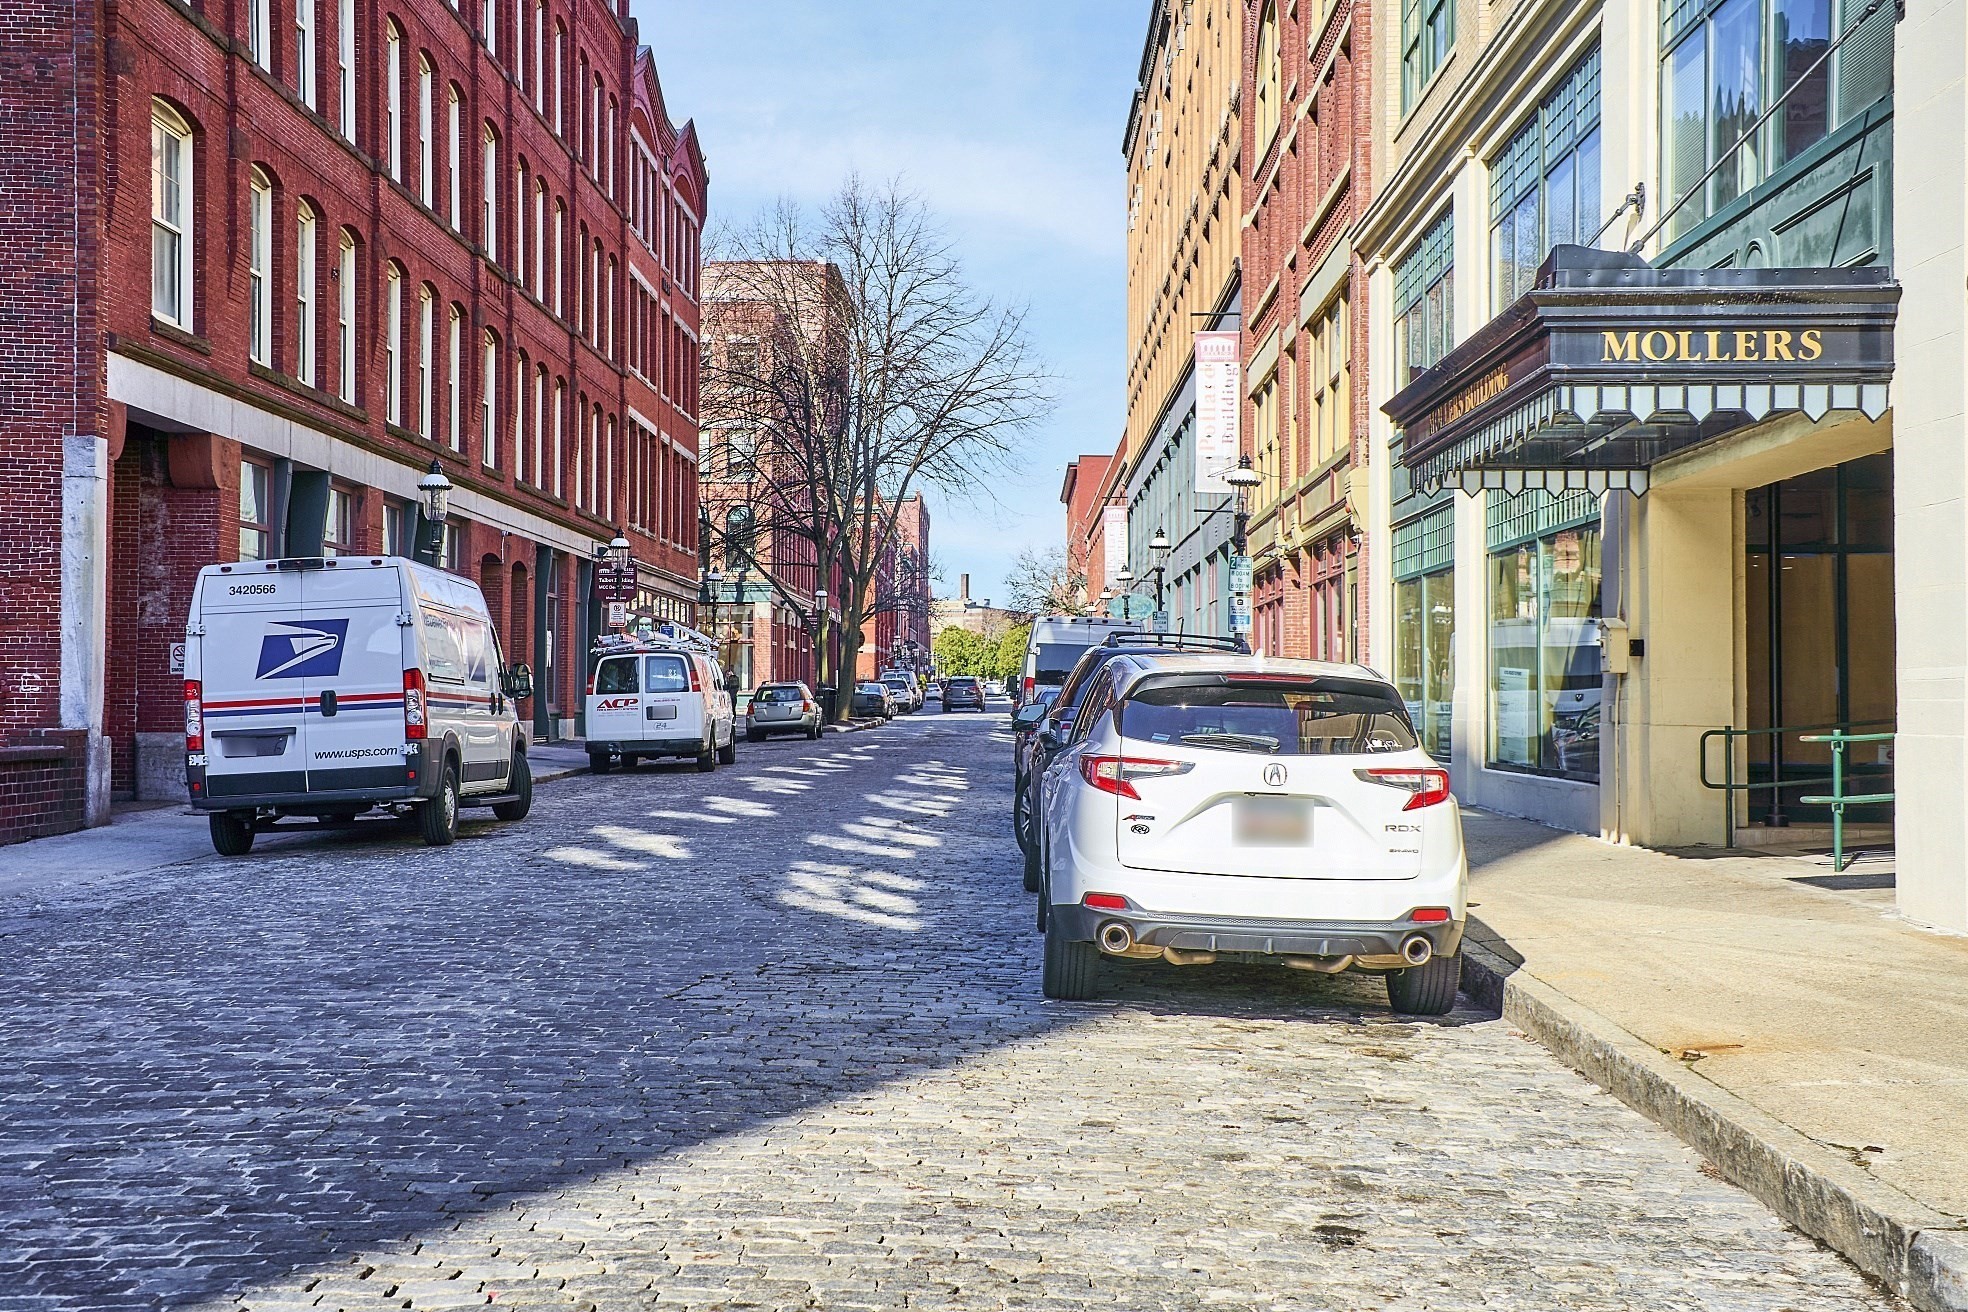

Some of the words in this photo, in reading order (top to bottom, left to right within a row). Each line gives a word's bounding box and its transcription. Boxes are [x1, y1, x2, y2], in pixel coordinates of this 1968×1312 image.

[1600, 329, 1823, 362] MOLLERS
[1464, 372, 1509, 414] BUILDING
[1221, 367, 1239, 444] Building
[1230, 557, 1236, 569] 2
[229, 584, 276, 595] 3420566
[596, 698, 639, 709] ACP
[314, 747, 398, 760] www.usps.com
[1384, 824, 1422, 832] RDX
